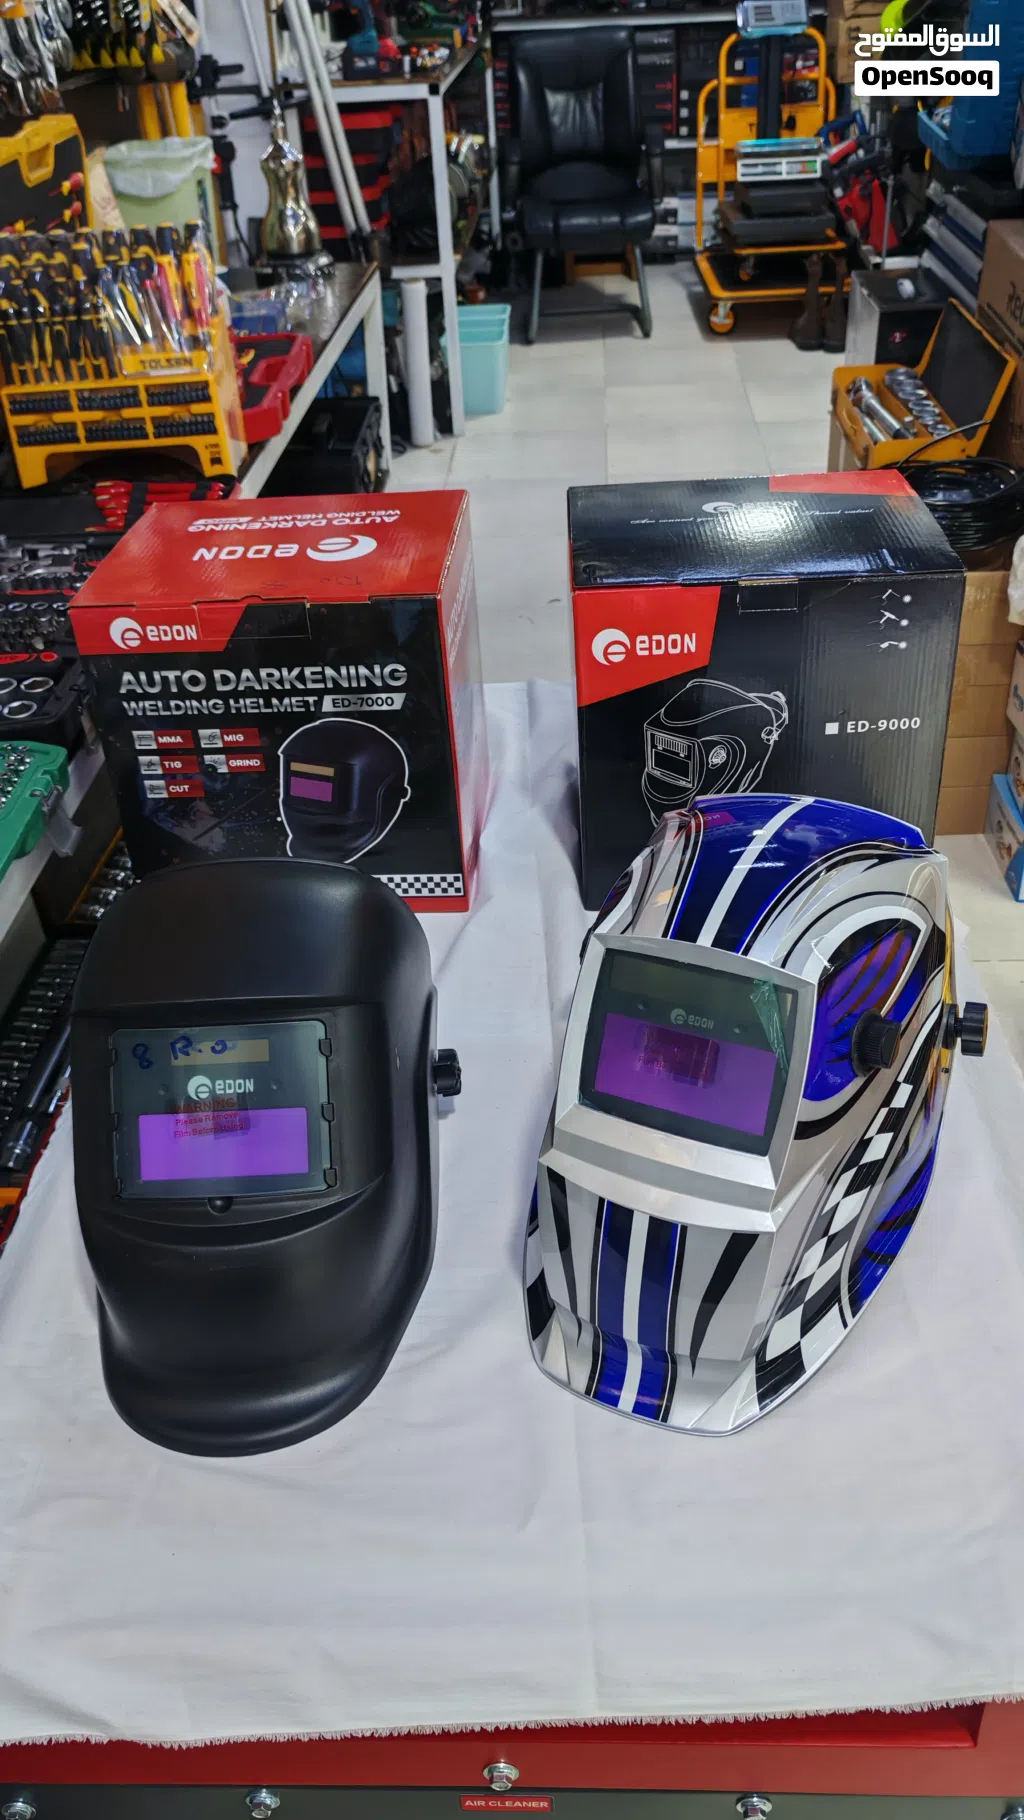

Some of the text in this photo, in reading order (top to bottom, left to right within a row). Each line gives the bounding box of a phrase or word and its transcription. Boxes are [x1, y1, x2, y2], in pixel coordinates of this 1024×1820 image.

[140, 358, 193, 369] TOLSEN
[258, 509, 401, 522] WELDING HELMET
[332, 515, 401, 526] AUTO
[187, 518, 328, 532] DARKENING
[119, 663, 408, 694] AUTO DARKENING
[121, 696, 394, 716] WELDING HELMET ED-7000
[846, 717, 921, 733] ED-9000
[157, 736, 183, 744] MMA
[223, 734, 244, 742] MIG
[163, 761, 182, 769] TIG
[229, 759, 260, 767] GRIND
[169, 785, 189, 793] CUT
[175, 1111, 239, 1127] Please Remove
[173, 1129, 191, 1139] Film
[192, 1126, 218, 1137] Before
[464, 1799, 549, 1808] AIR CLEANER
